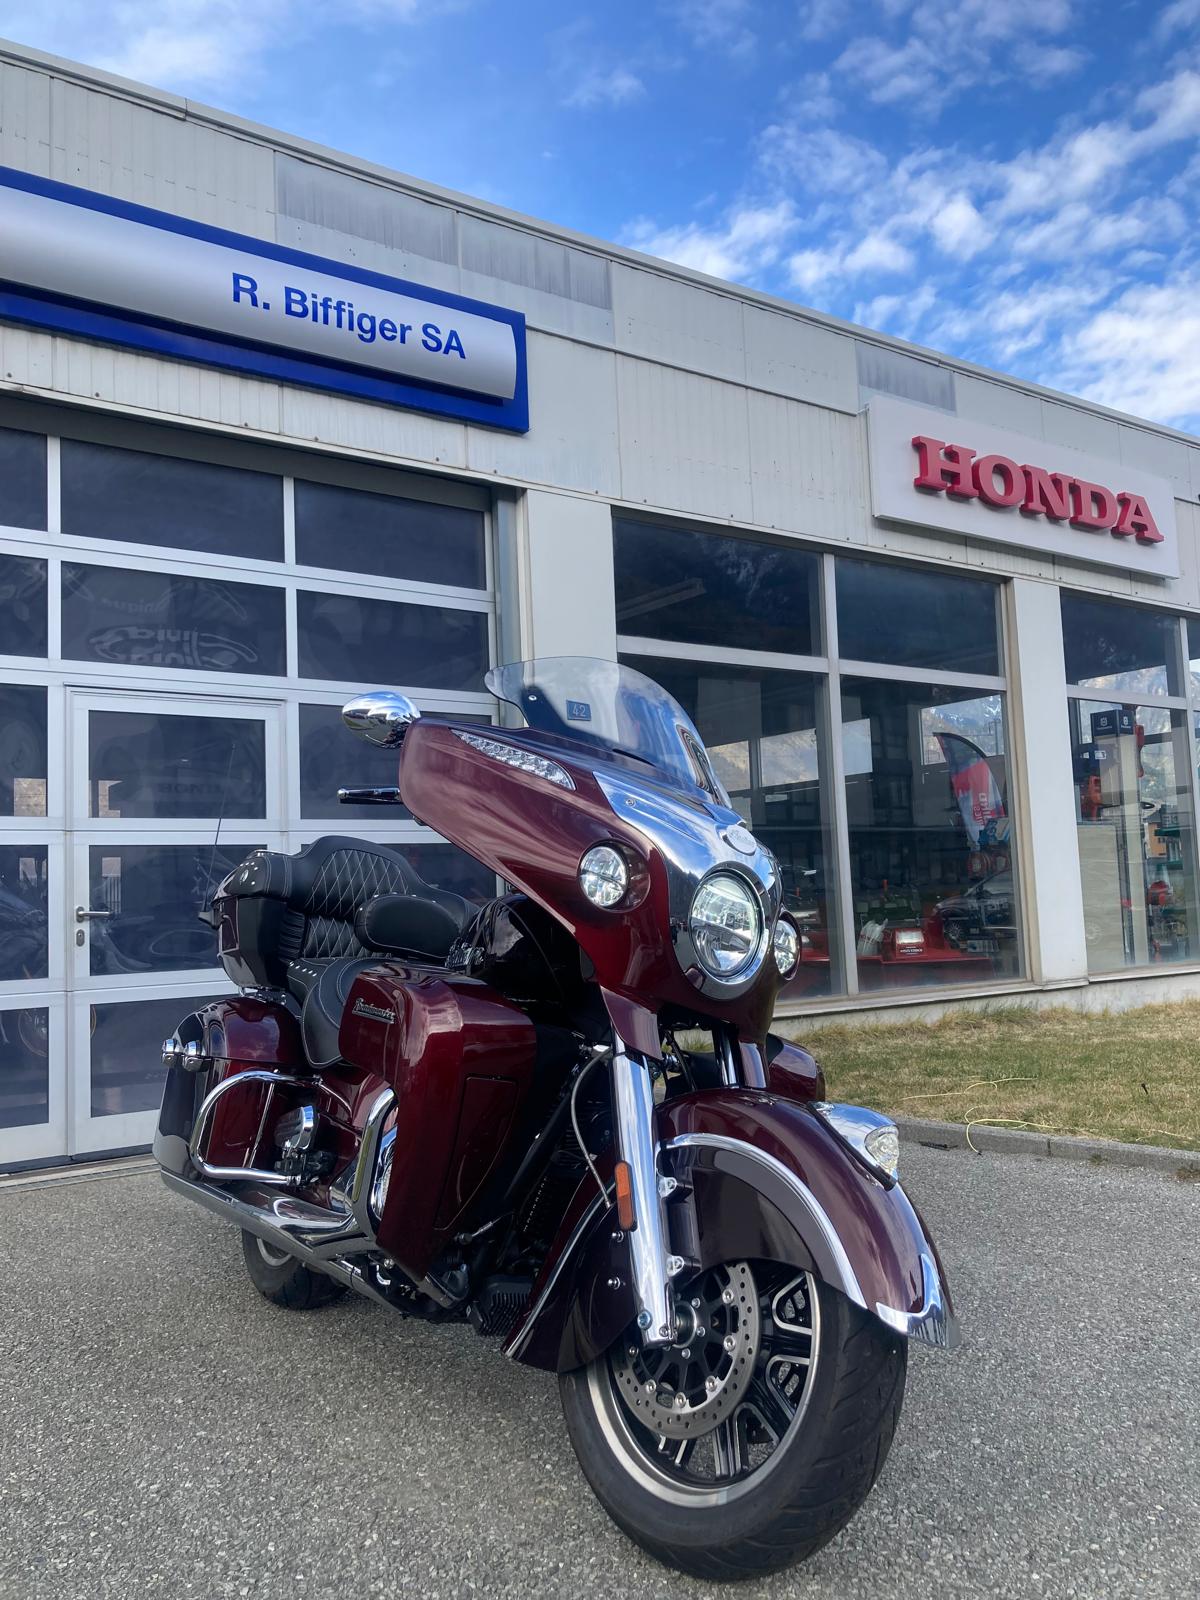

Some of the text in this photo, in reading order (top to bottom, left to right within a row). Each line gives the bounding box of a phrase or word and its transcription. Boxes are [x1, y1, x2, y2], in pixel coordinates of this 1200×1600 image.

[232, 272, 466, 359] R. Biffiger SA
[911, 435, 1165, 543] HONDA
[572, 703, 587, 717] 42
